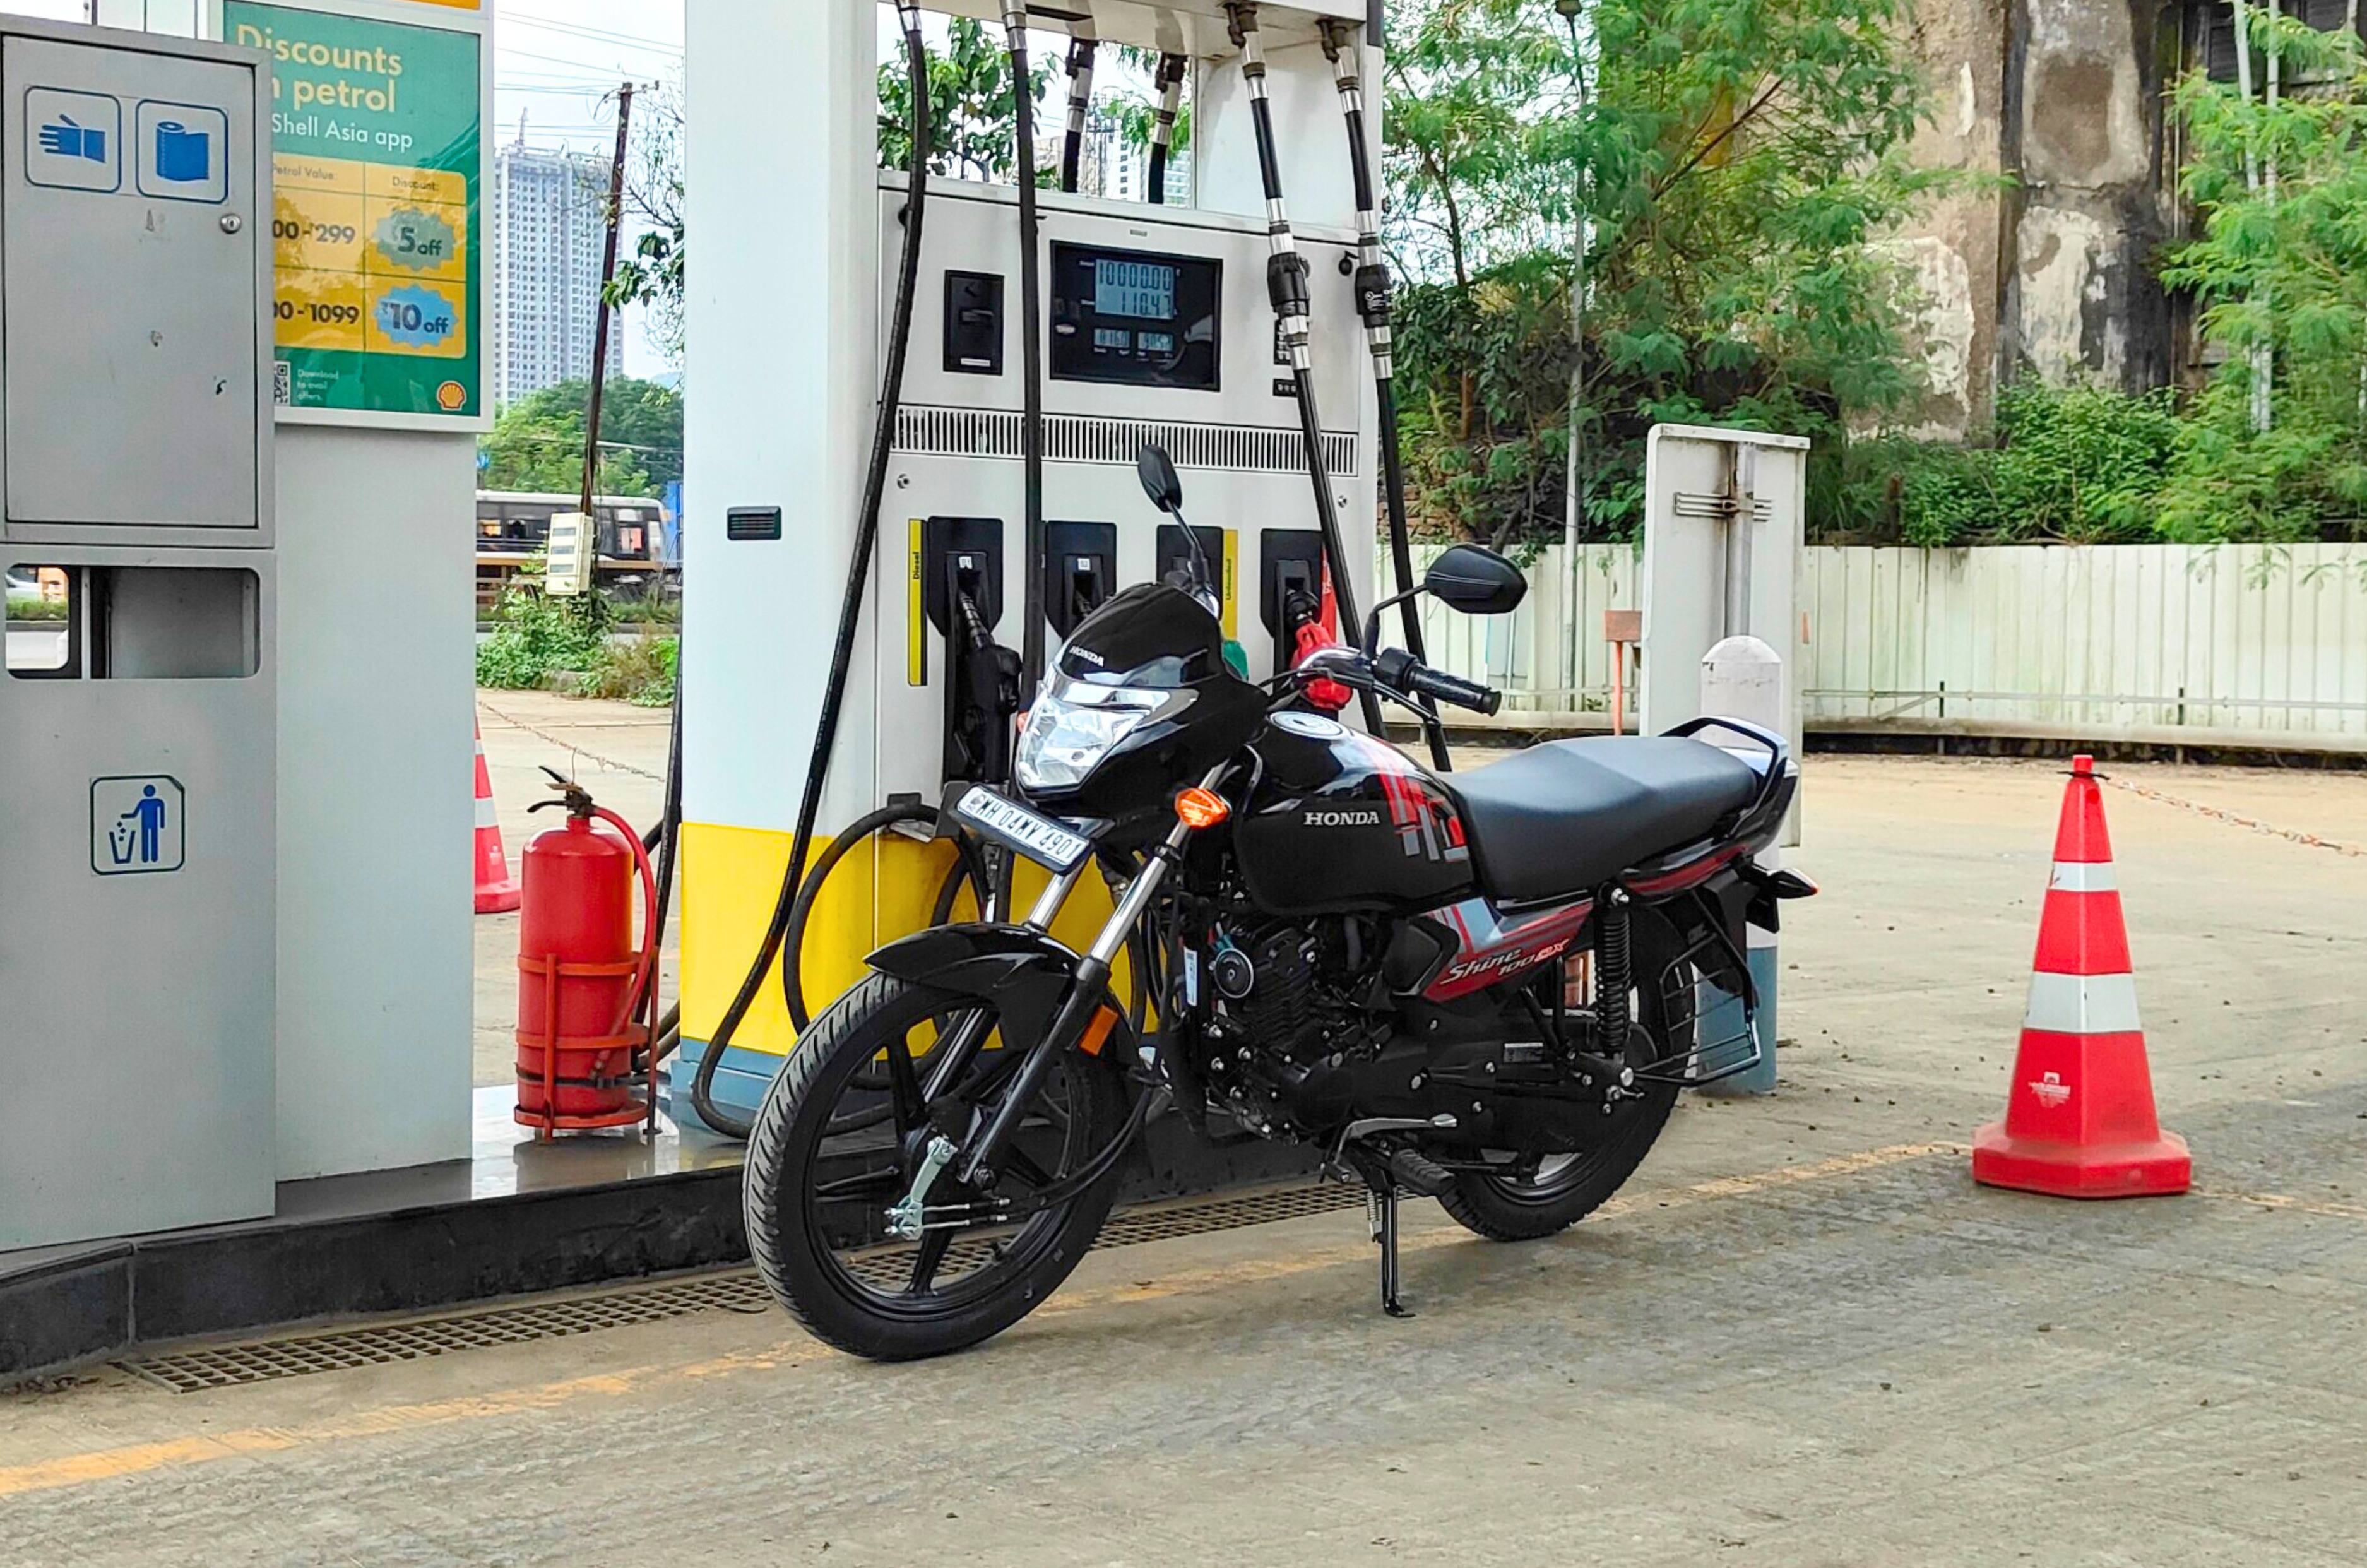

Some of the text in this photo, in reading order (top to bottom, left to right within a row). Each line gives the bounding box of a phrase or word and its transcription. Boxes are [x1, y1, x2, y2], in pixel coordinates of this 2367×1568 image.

[236, 23, 403, 76] Discounts
[294, 79, 396, 113] petrol
[272, 114, 413, 153] Shell Asia app
[417, 239, 442, 256] off
[424, 316, 449, 333] off
[1069, 645, 1105, 667] HONDA
[1303, 811, 1380, 826] HONDA
[1440, 949, 1522, 985] Shine
